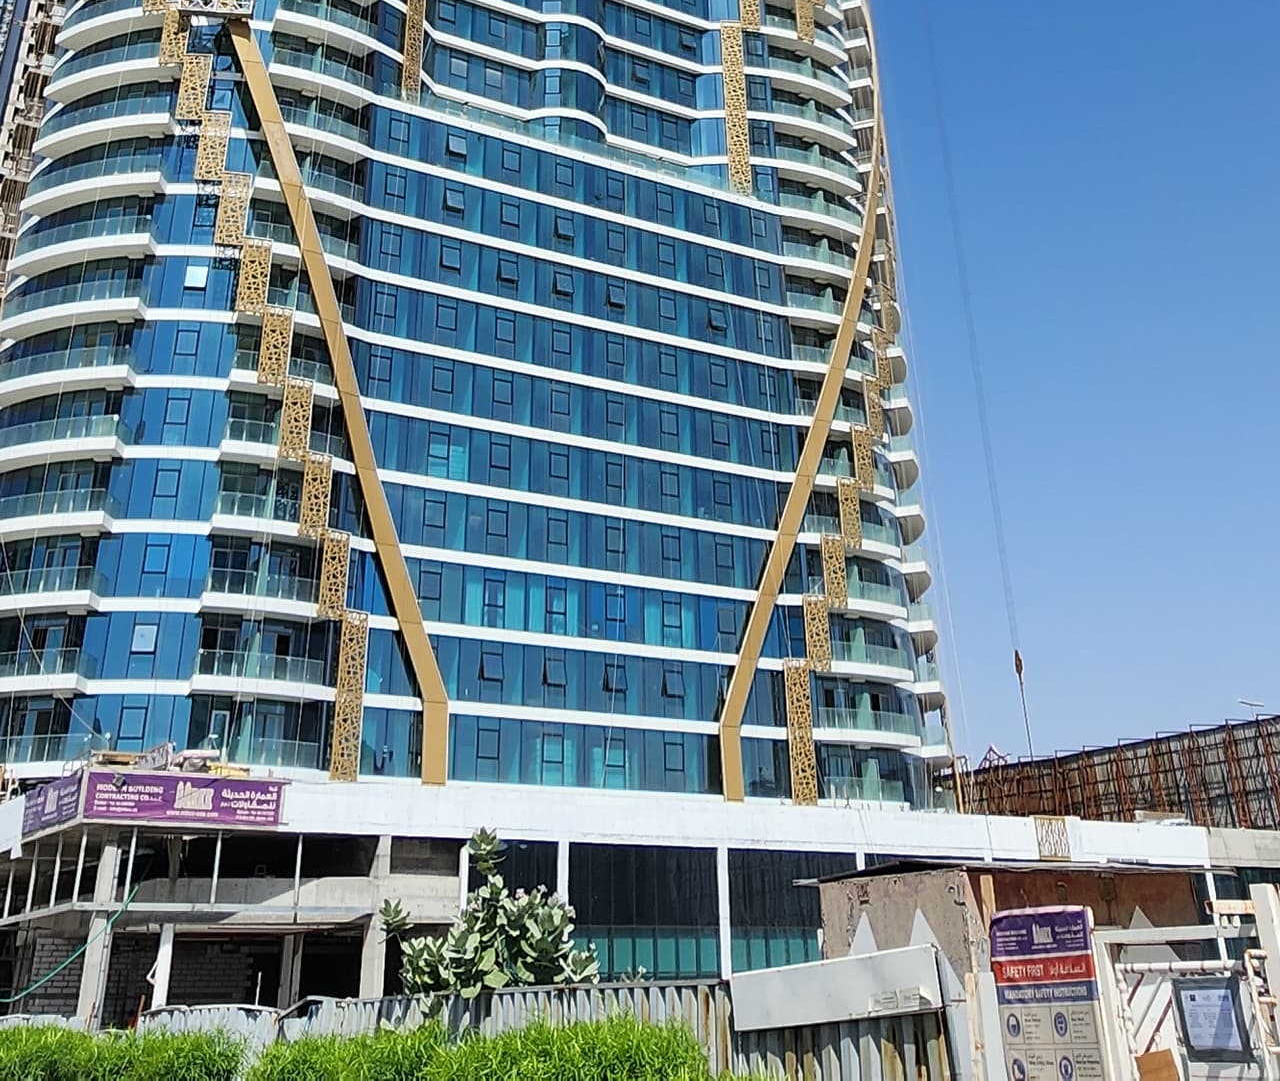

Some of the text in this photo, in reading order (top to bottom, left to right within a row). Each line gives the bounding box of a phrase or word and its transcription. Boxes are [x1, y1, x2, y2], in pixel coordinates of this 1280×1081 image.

[96, 784, 164, 794] MODN BUILDING
[95, 793, 139, 801] CONTRACTING
[1002, 964, 1045, 979] SAFETY FIRST
[1035, 987, 1053, 998] SAFETY
